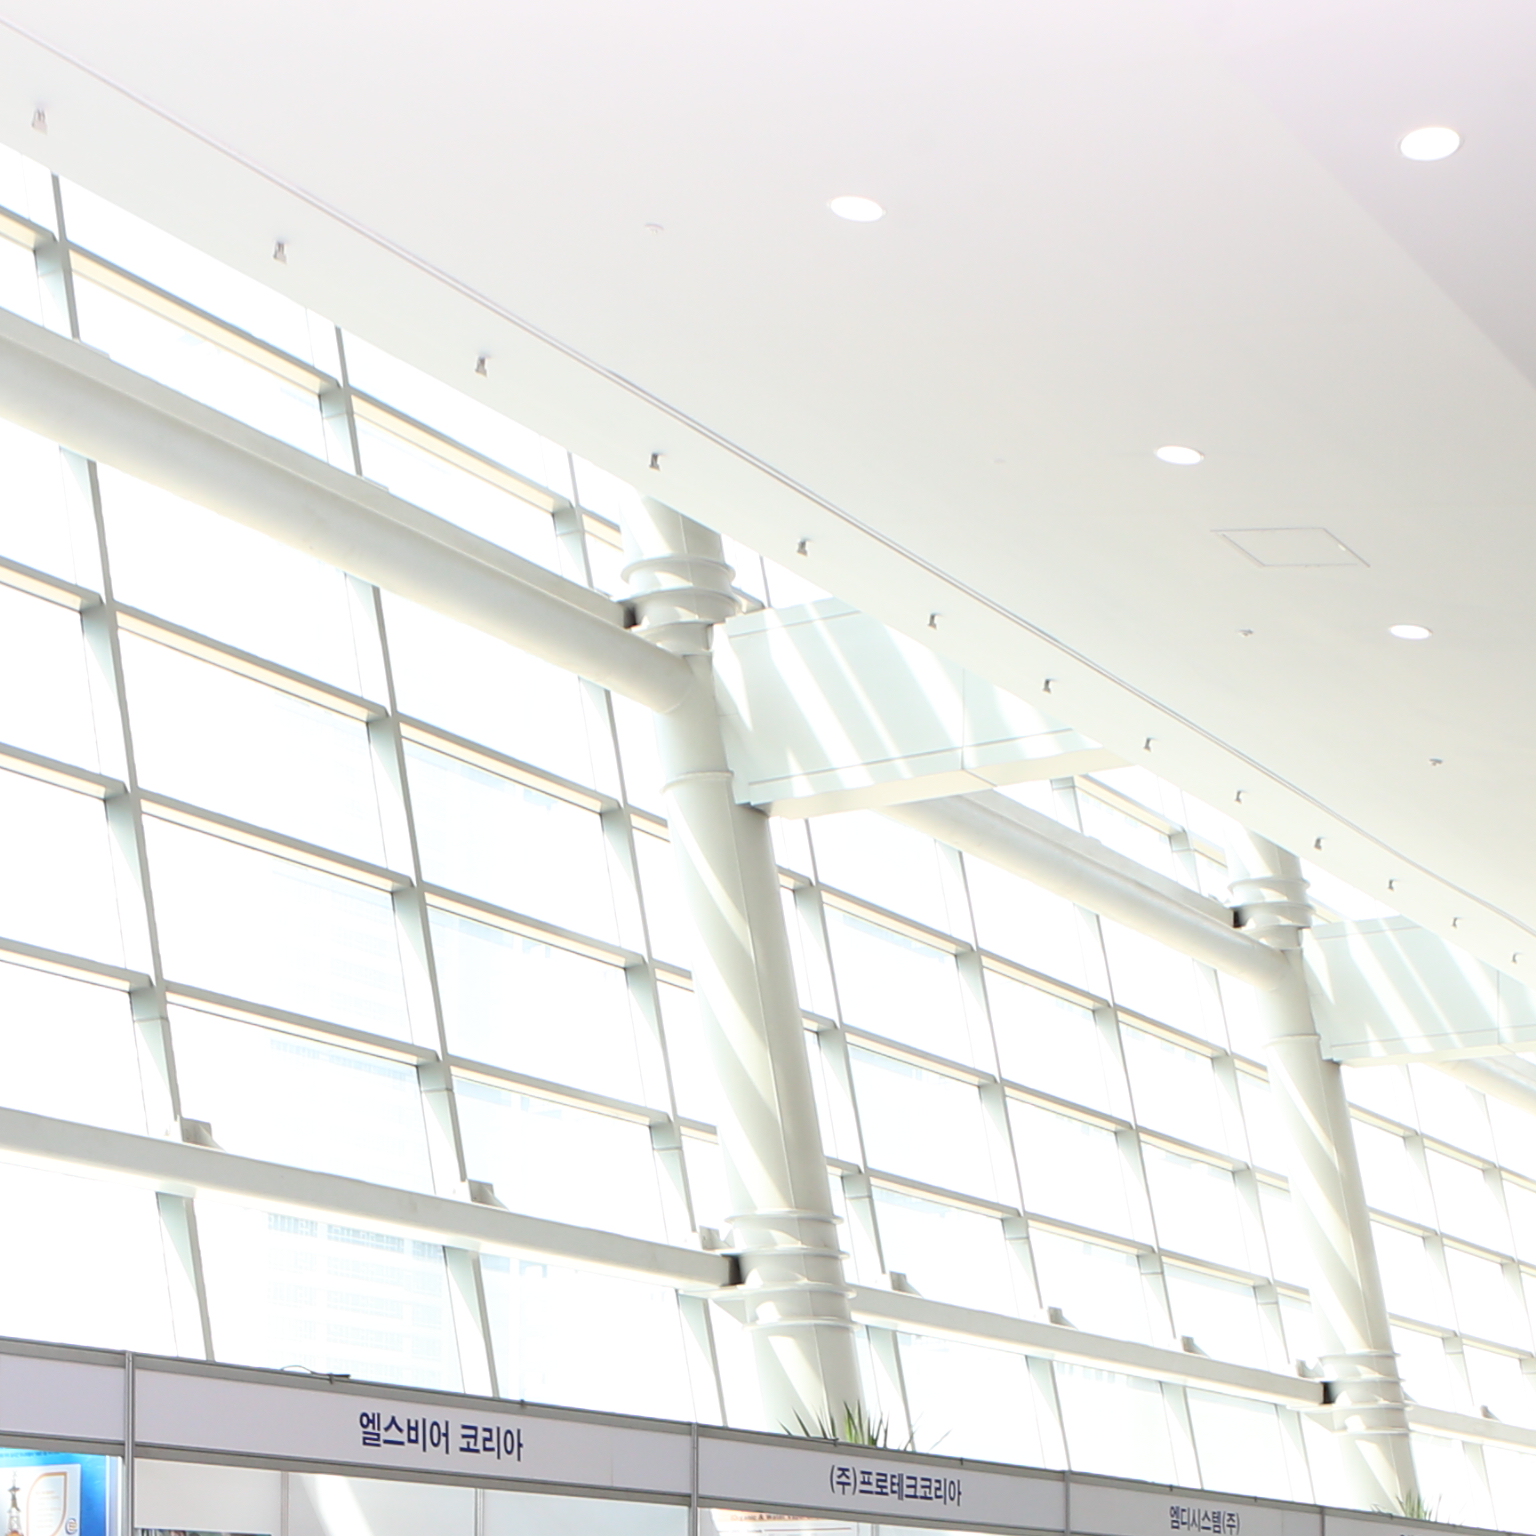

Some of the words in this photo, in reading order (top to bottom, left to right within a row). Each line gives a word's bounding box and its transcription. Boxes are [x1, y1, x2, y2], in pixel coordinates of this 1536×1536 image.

[358, 1411, 452, 1456] 엘스비어
[459, 1422, 525, 1463] 코리아
[829, 1462, 963, 1507] (주)프로테크코리아
[1169, 1504, 1241, 1536] 엠디시스템(주)
